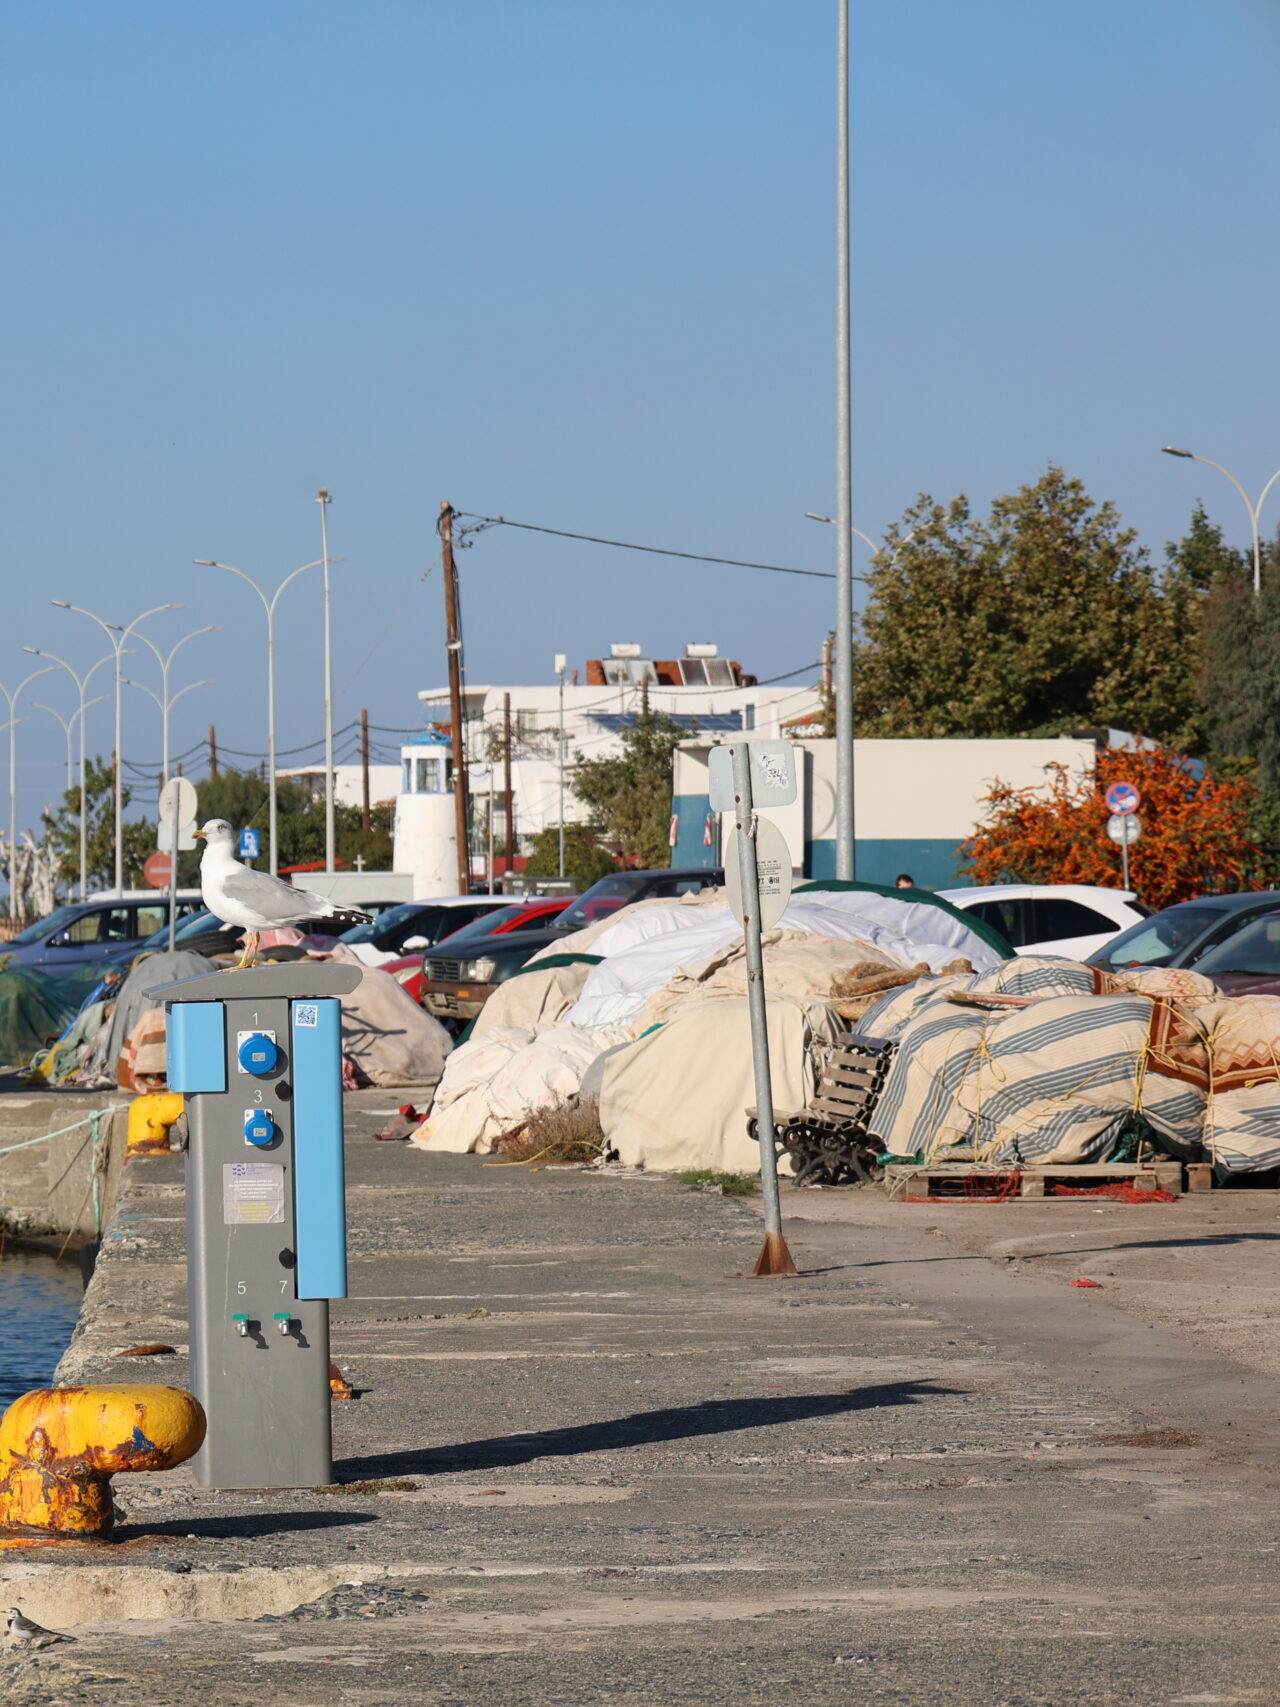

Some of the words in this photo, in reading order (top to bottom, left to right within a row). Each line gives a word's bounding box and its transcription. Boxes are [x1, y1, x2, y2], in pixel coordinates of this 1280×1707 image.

[252, 1012, 258, 1025] 1
[254, 1089, 263, 1104] 3
[237, 1281, 247, 1295] 5
[279, 1280, 288, 1293] 7
